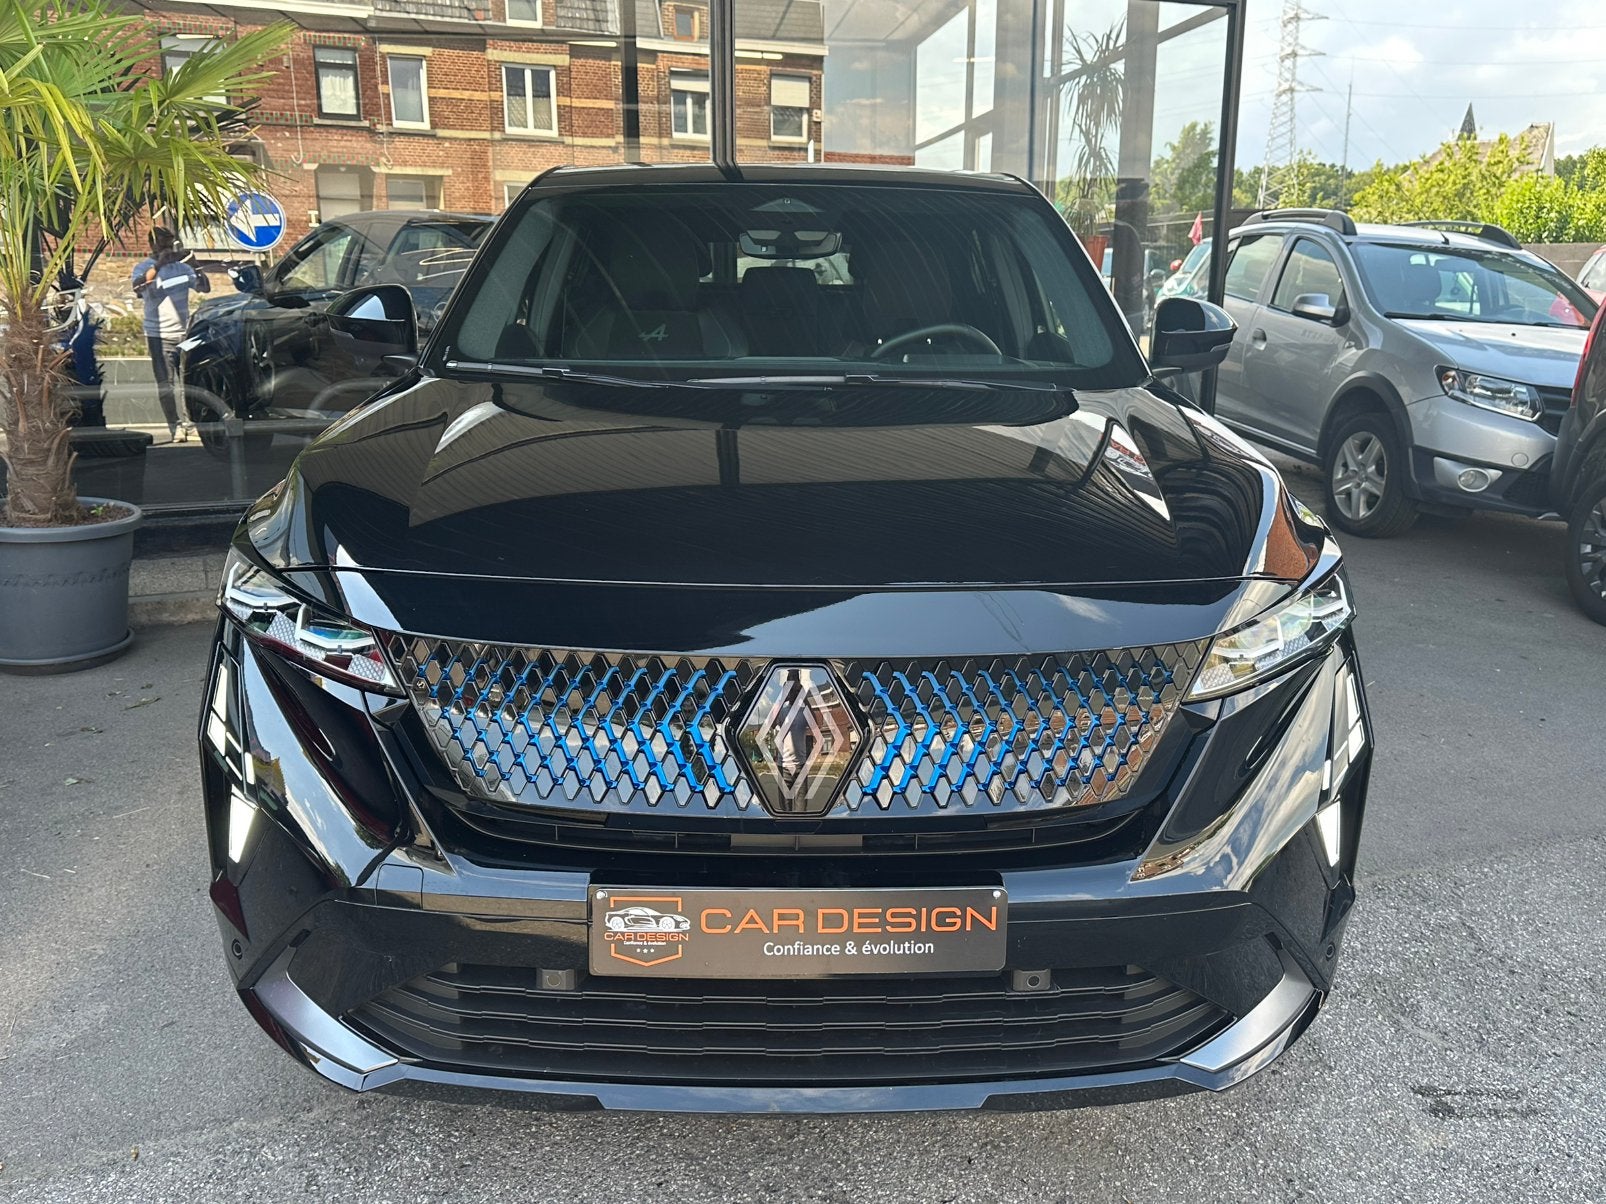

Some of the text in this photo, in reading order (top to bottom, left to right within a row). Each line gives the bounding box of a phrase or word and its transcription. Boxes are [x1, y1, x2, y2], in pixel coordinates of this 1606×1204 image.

[700, 906, 997, 934] CAR DESIGN
[604, 932, 689, 941] CAR DESIGN
[763, 940, 934, 956] Confiance & évolution
